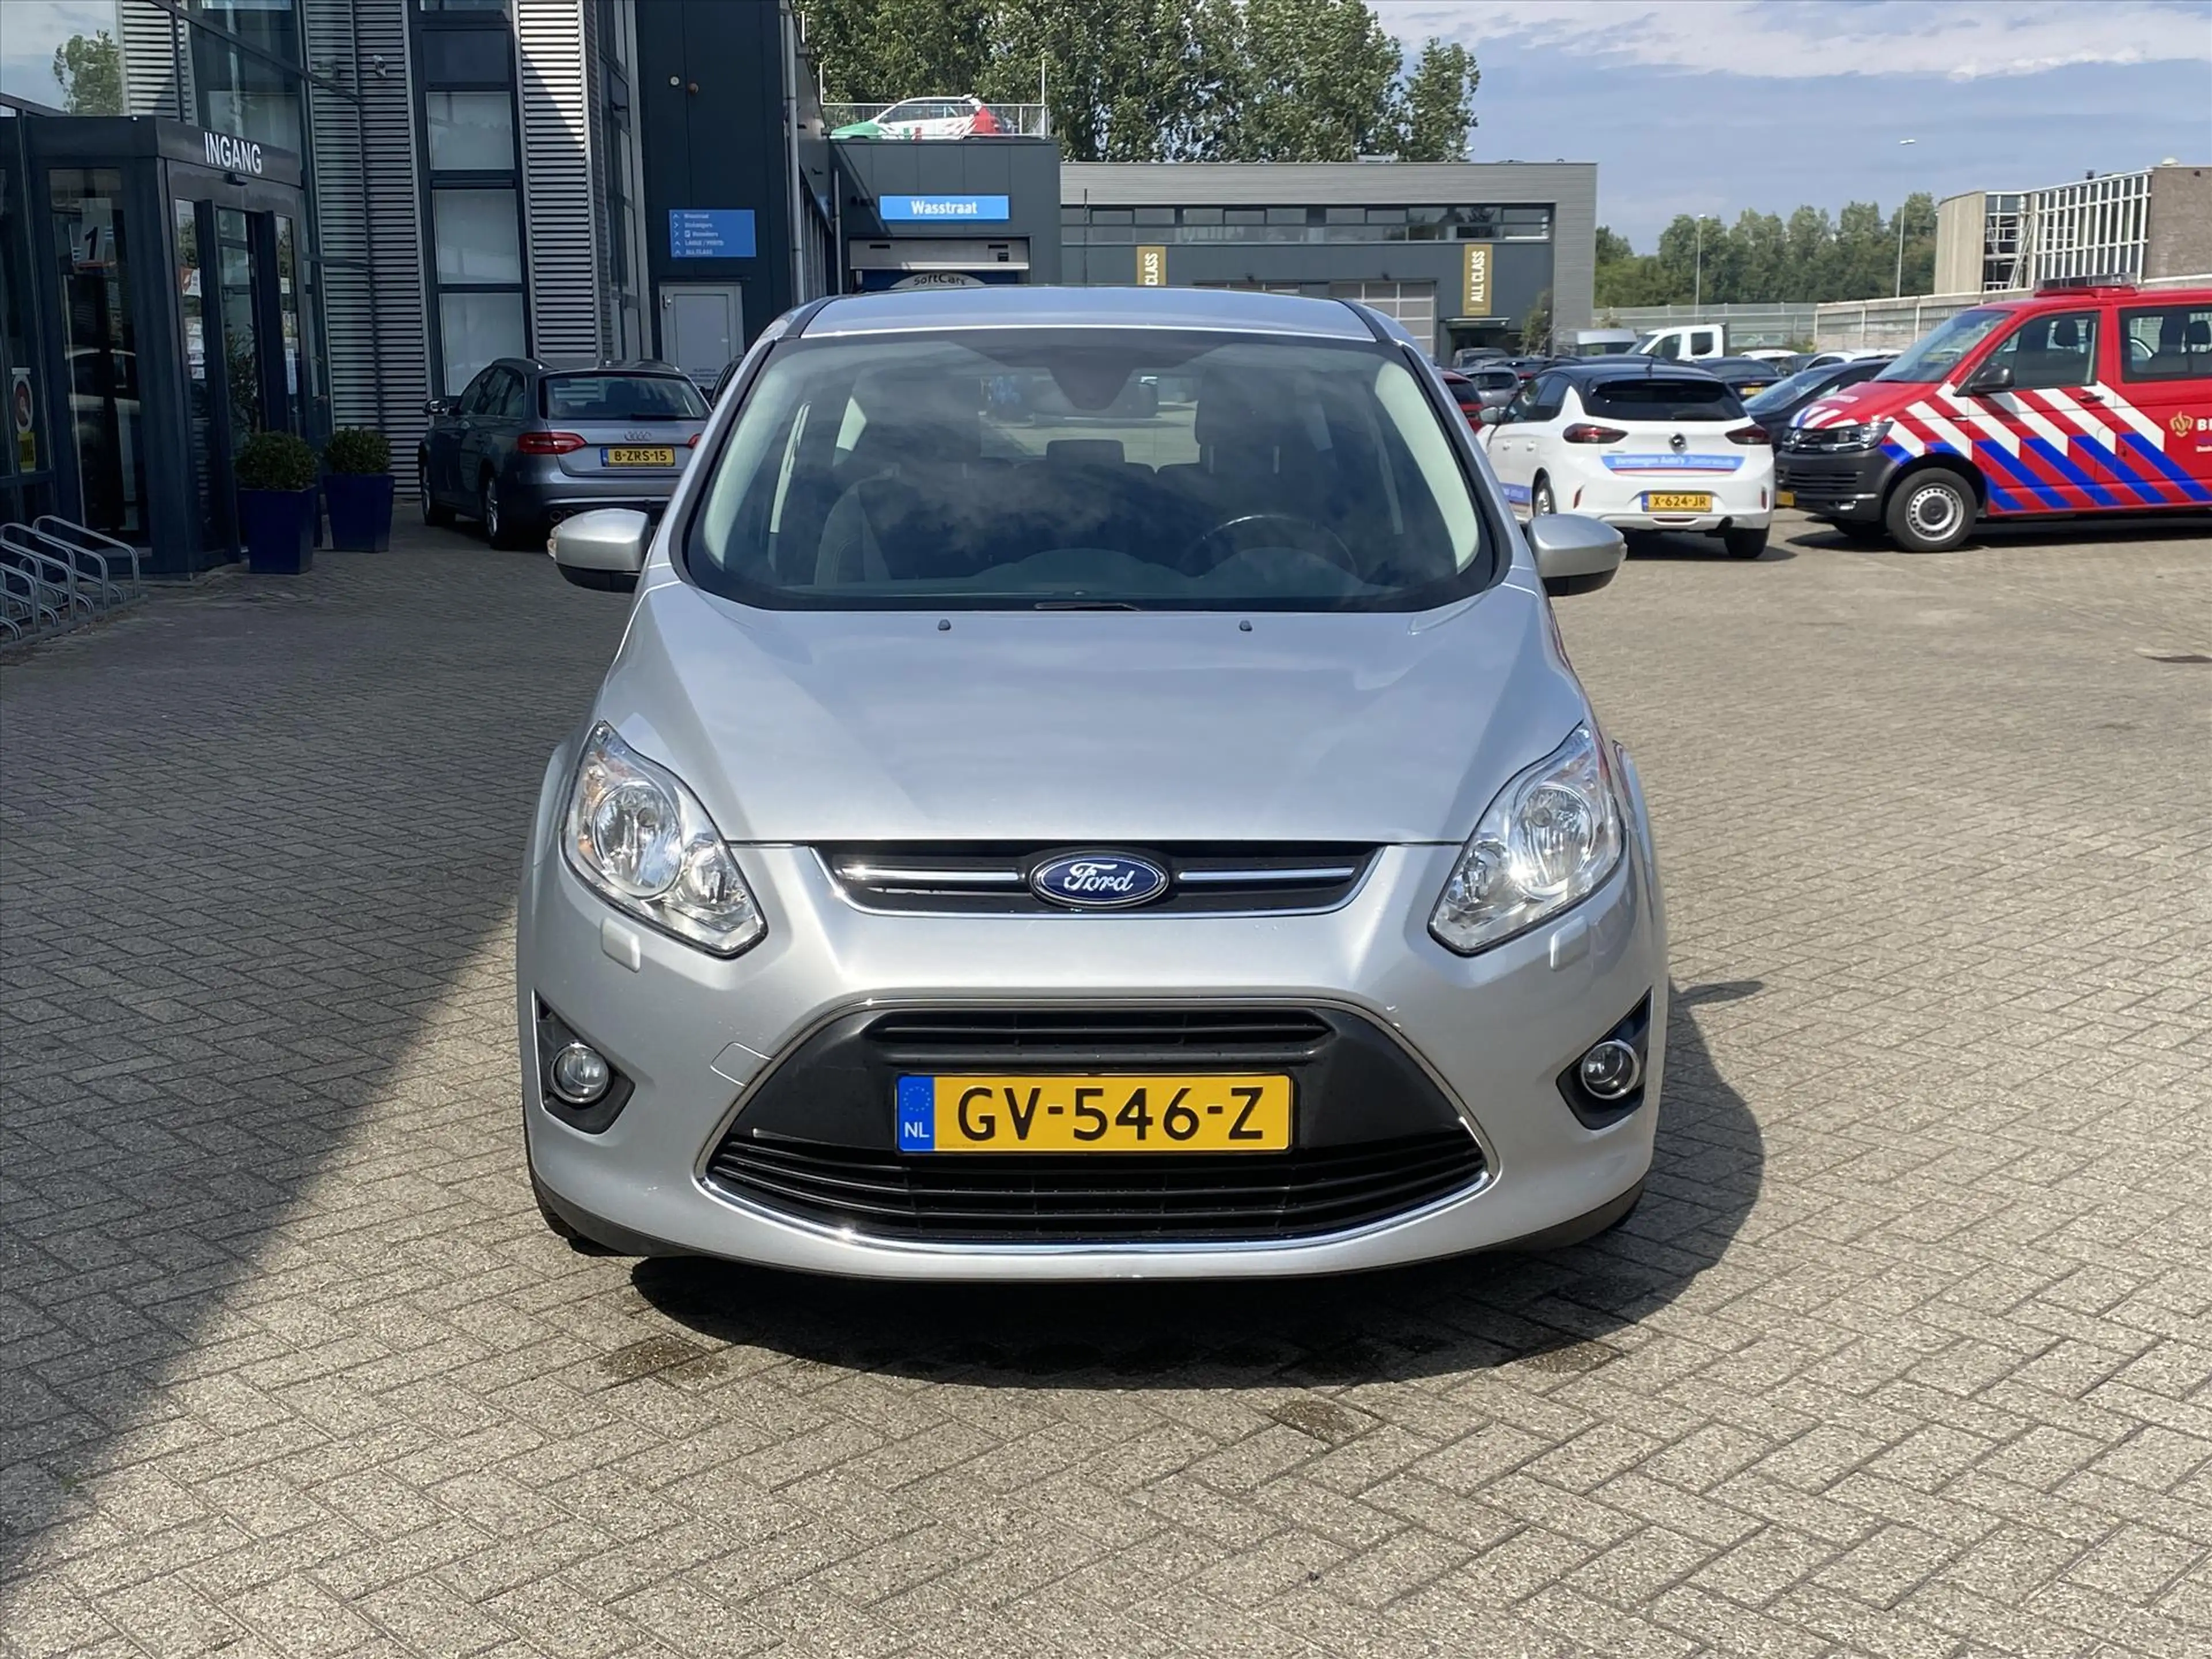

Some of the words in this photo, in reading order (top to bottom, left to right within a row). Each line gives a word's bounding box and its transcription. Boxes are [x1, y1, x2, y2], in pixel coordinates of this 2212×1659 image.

[204, 131, 262, 175] INGANG
[910, 200, 978, 215] Wasstraat
[1471, 250, 1485, 282] CLASS
[1471, 283, 1484, 302] ALL
[1653, 497, 1706, 506] X-624-JR
[1063, 862, 1135, 892] Ford
[957, 1086, 1264, 1141] GV-546-Z
[904, 1121, 930, 1138] NL
